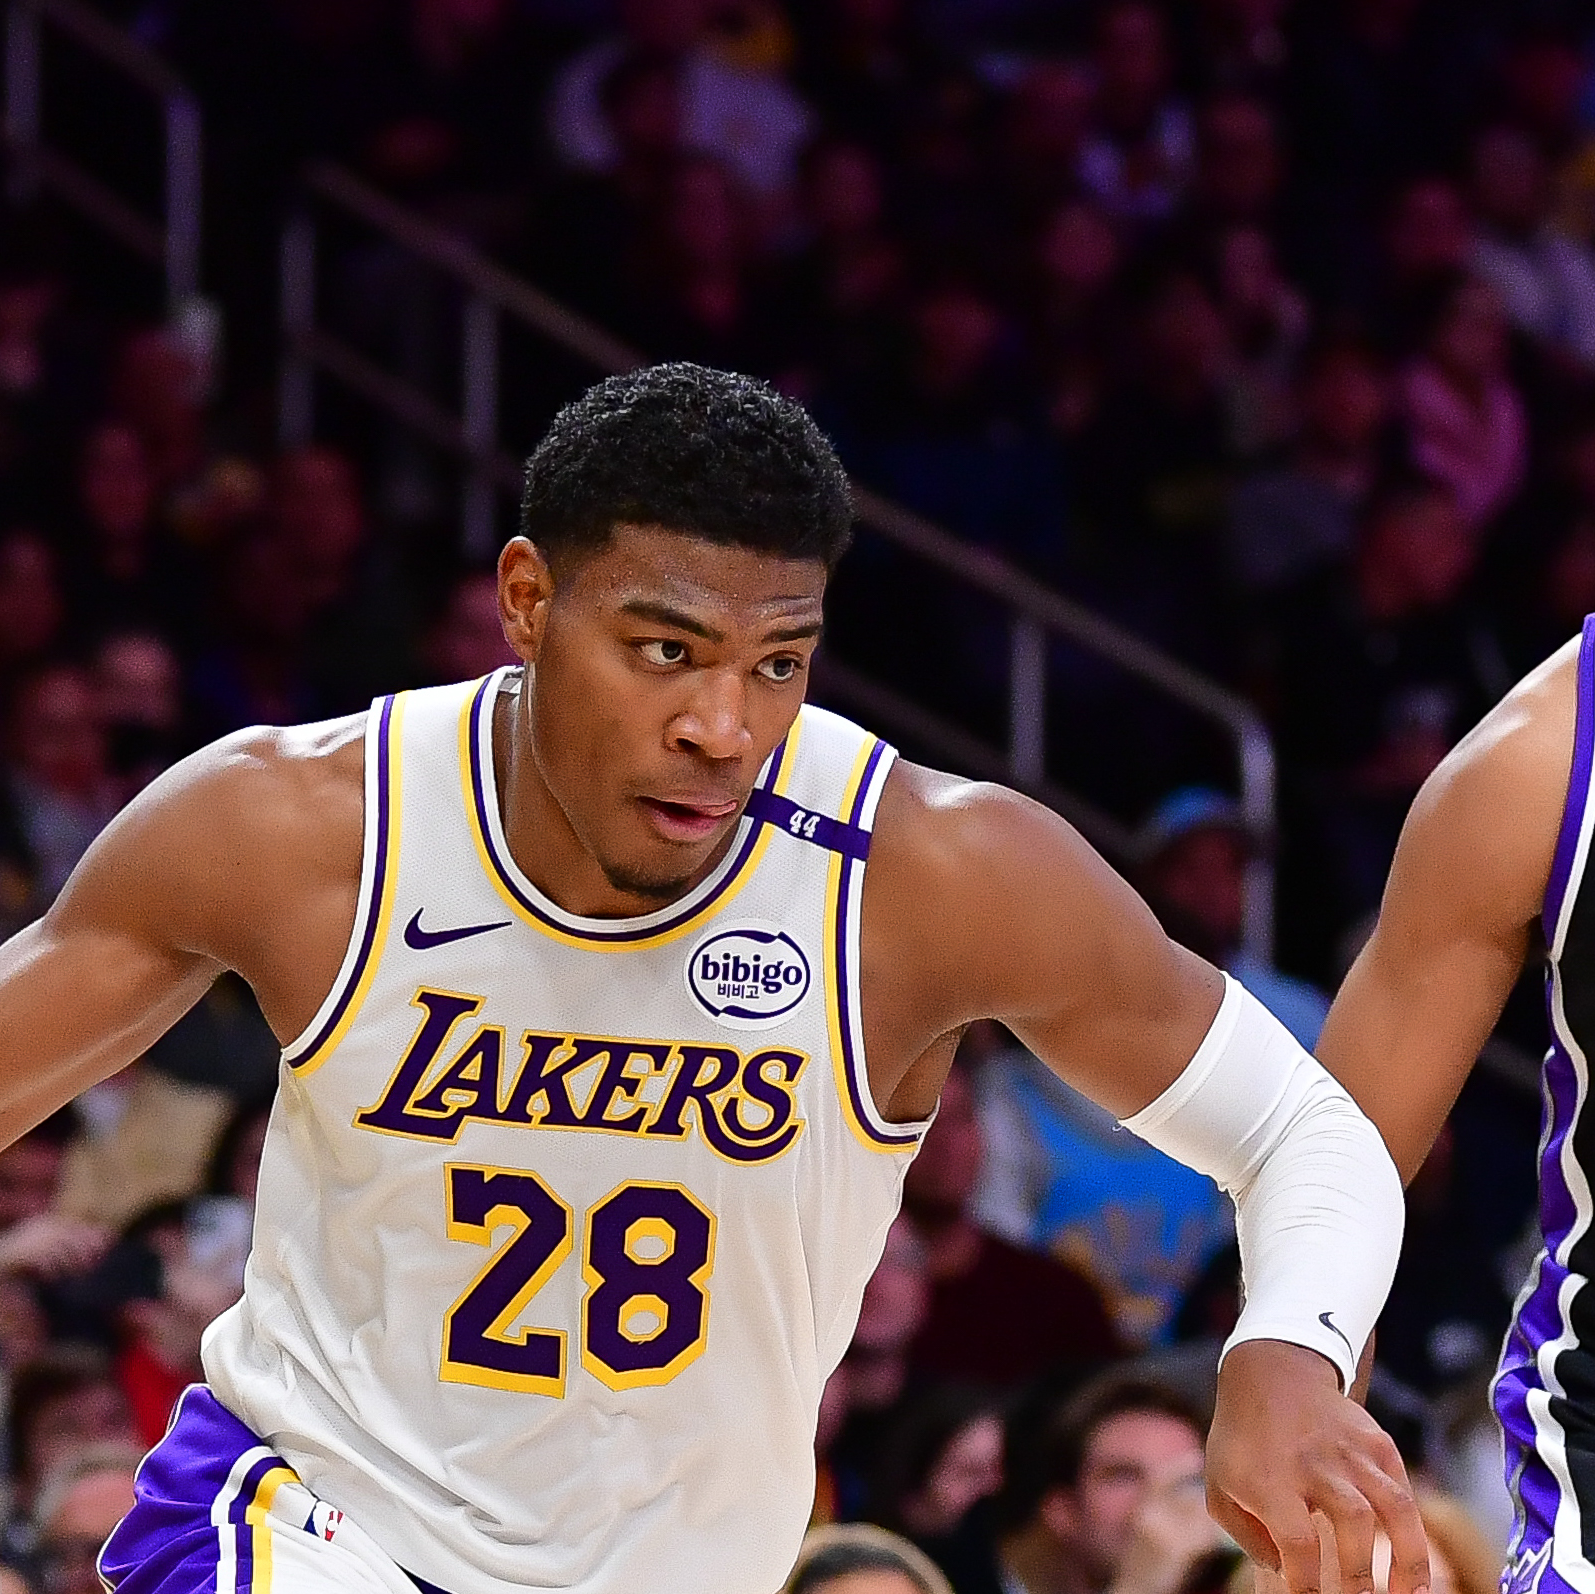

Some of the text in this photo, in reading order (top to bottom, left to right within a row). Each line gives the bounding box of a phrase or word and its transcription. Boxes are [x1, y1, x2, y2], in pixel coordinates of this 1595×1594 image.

[789, 810, 821, 838] 44
[701, 952, 803, 994] bibigo
[717, 983, 760, 999] 비비고
[351, 984, 812, 1167] LAKERS
[438, 1161, 718, 1400] 28
